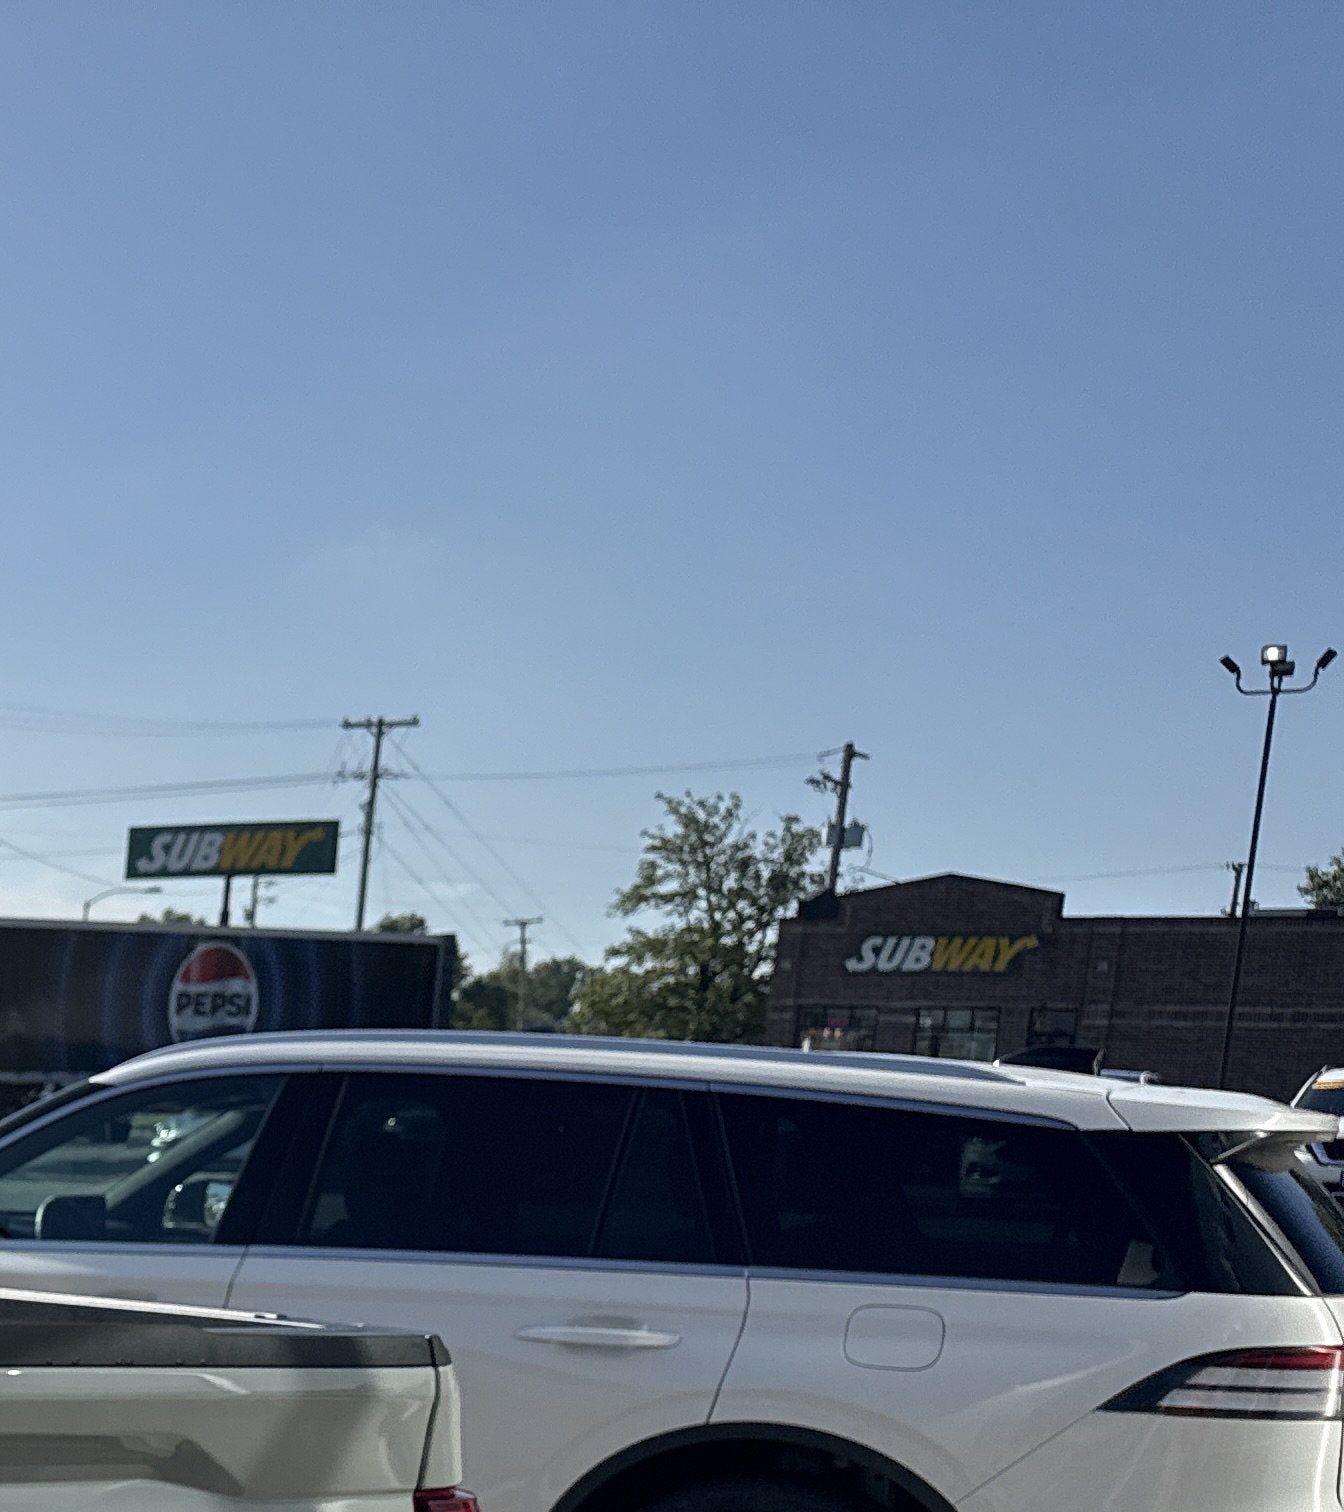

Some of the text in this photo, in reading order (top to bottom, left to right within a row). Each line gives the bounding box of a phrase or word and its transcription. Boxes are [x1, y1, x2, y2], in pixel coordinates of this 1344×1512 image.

[135, 827, 326, 873] SUBWAY
[845, 934, 1040, 973] SUBWAY
[176, 991, 252, 1017] PEPSI
